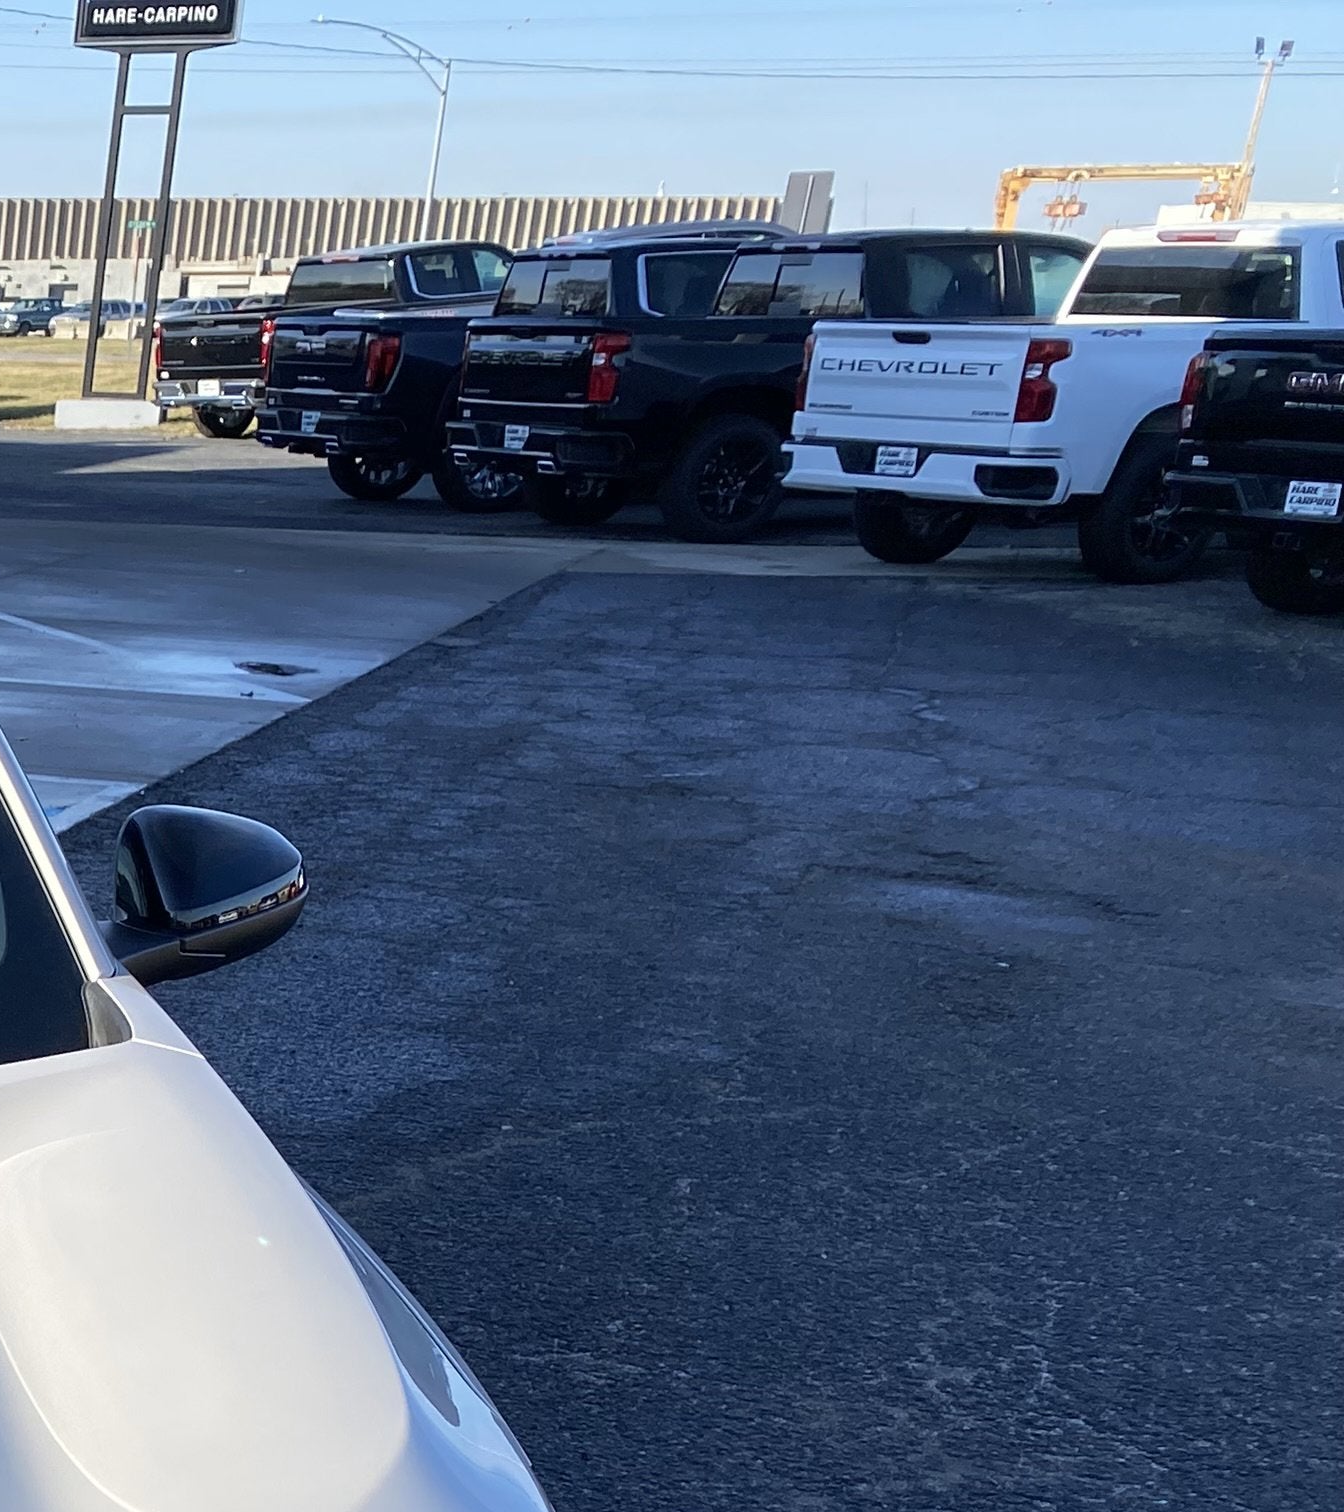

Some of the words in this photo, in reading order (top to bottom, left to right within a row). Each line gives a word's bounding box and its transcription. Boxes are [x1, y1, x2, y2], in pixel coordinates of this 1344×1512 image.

[92, 5, 219, 24] HARE-CARPINO
[819, 357, 1004, 377] CHEVROLET
[1286, 371, 1344, 393] GM
[1290, 484, 1321, 495] HARE
[1288, 495, 1337, 507] CARPINO
